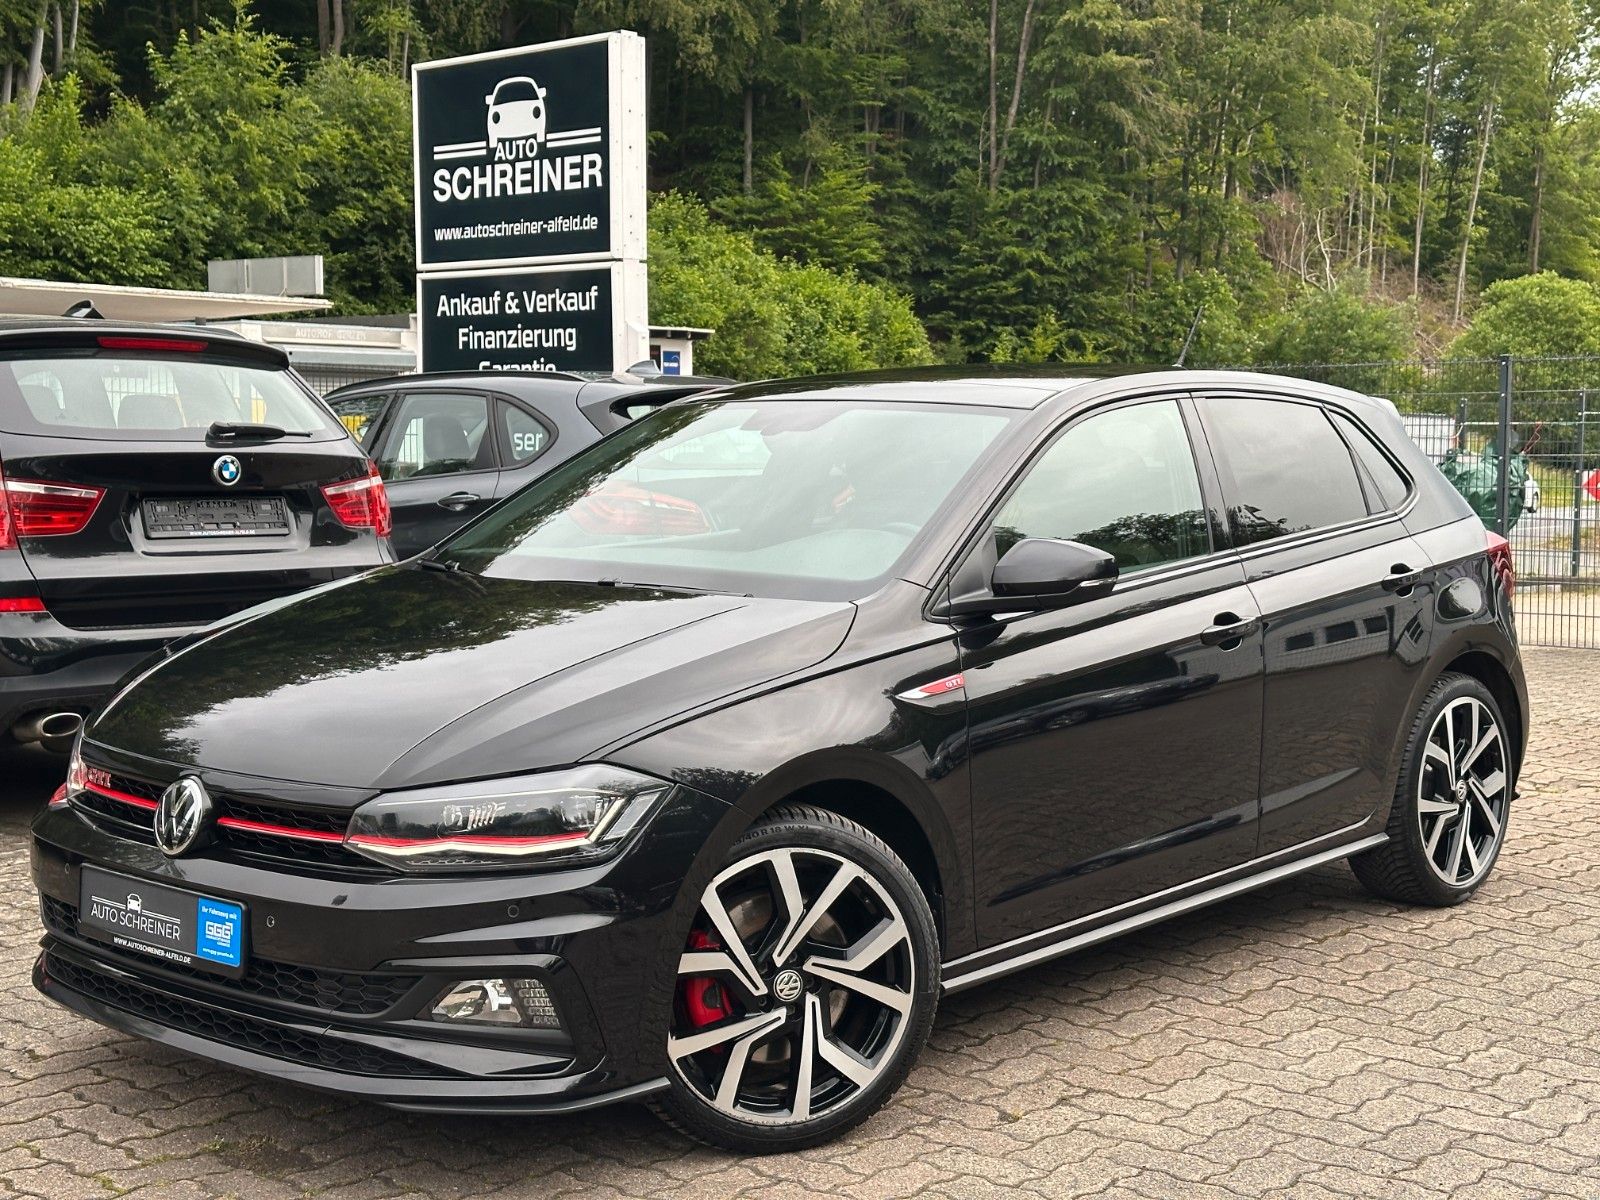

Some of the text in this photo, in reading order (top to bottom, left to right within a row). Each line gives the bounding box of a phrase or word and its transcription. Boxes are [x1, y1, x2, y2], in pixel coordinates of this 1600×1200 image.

[494, 138, 538, 161] AUTO
[433, 153, 603, 202] SCHREINER
[434, 214, 598, 241] www.autoschreiner-alfeld.de
[437, 286, 598, 316] Ankauf & Verkauf
[458, 324, 577, 351] Finanzierung
[513, 432, 543, 451] ser
[91, 903, 181, 940] AUTO SCHREINER
